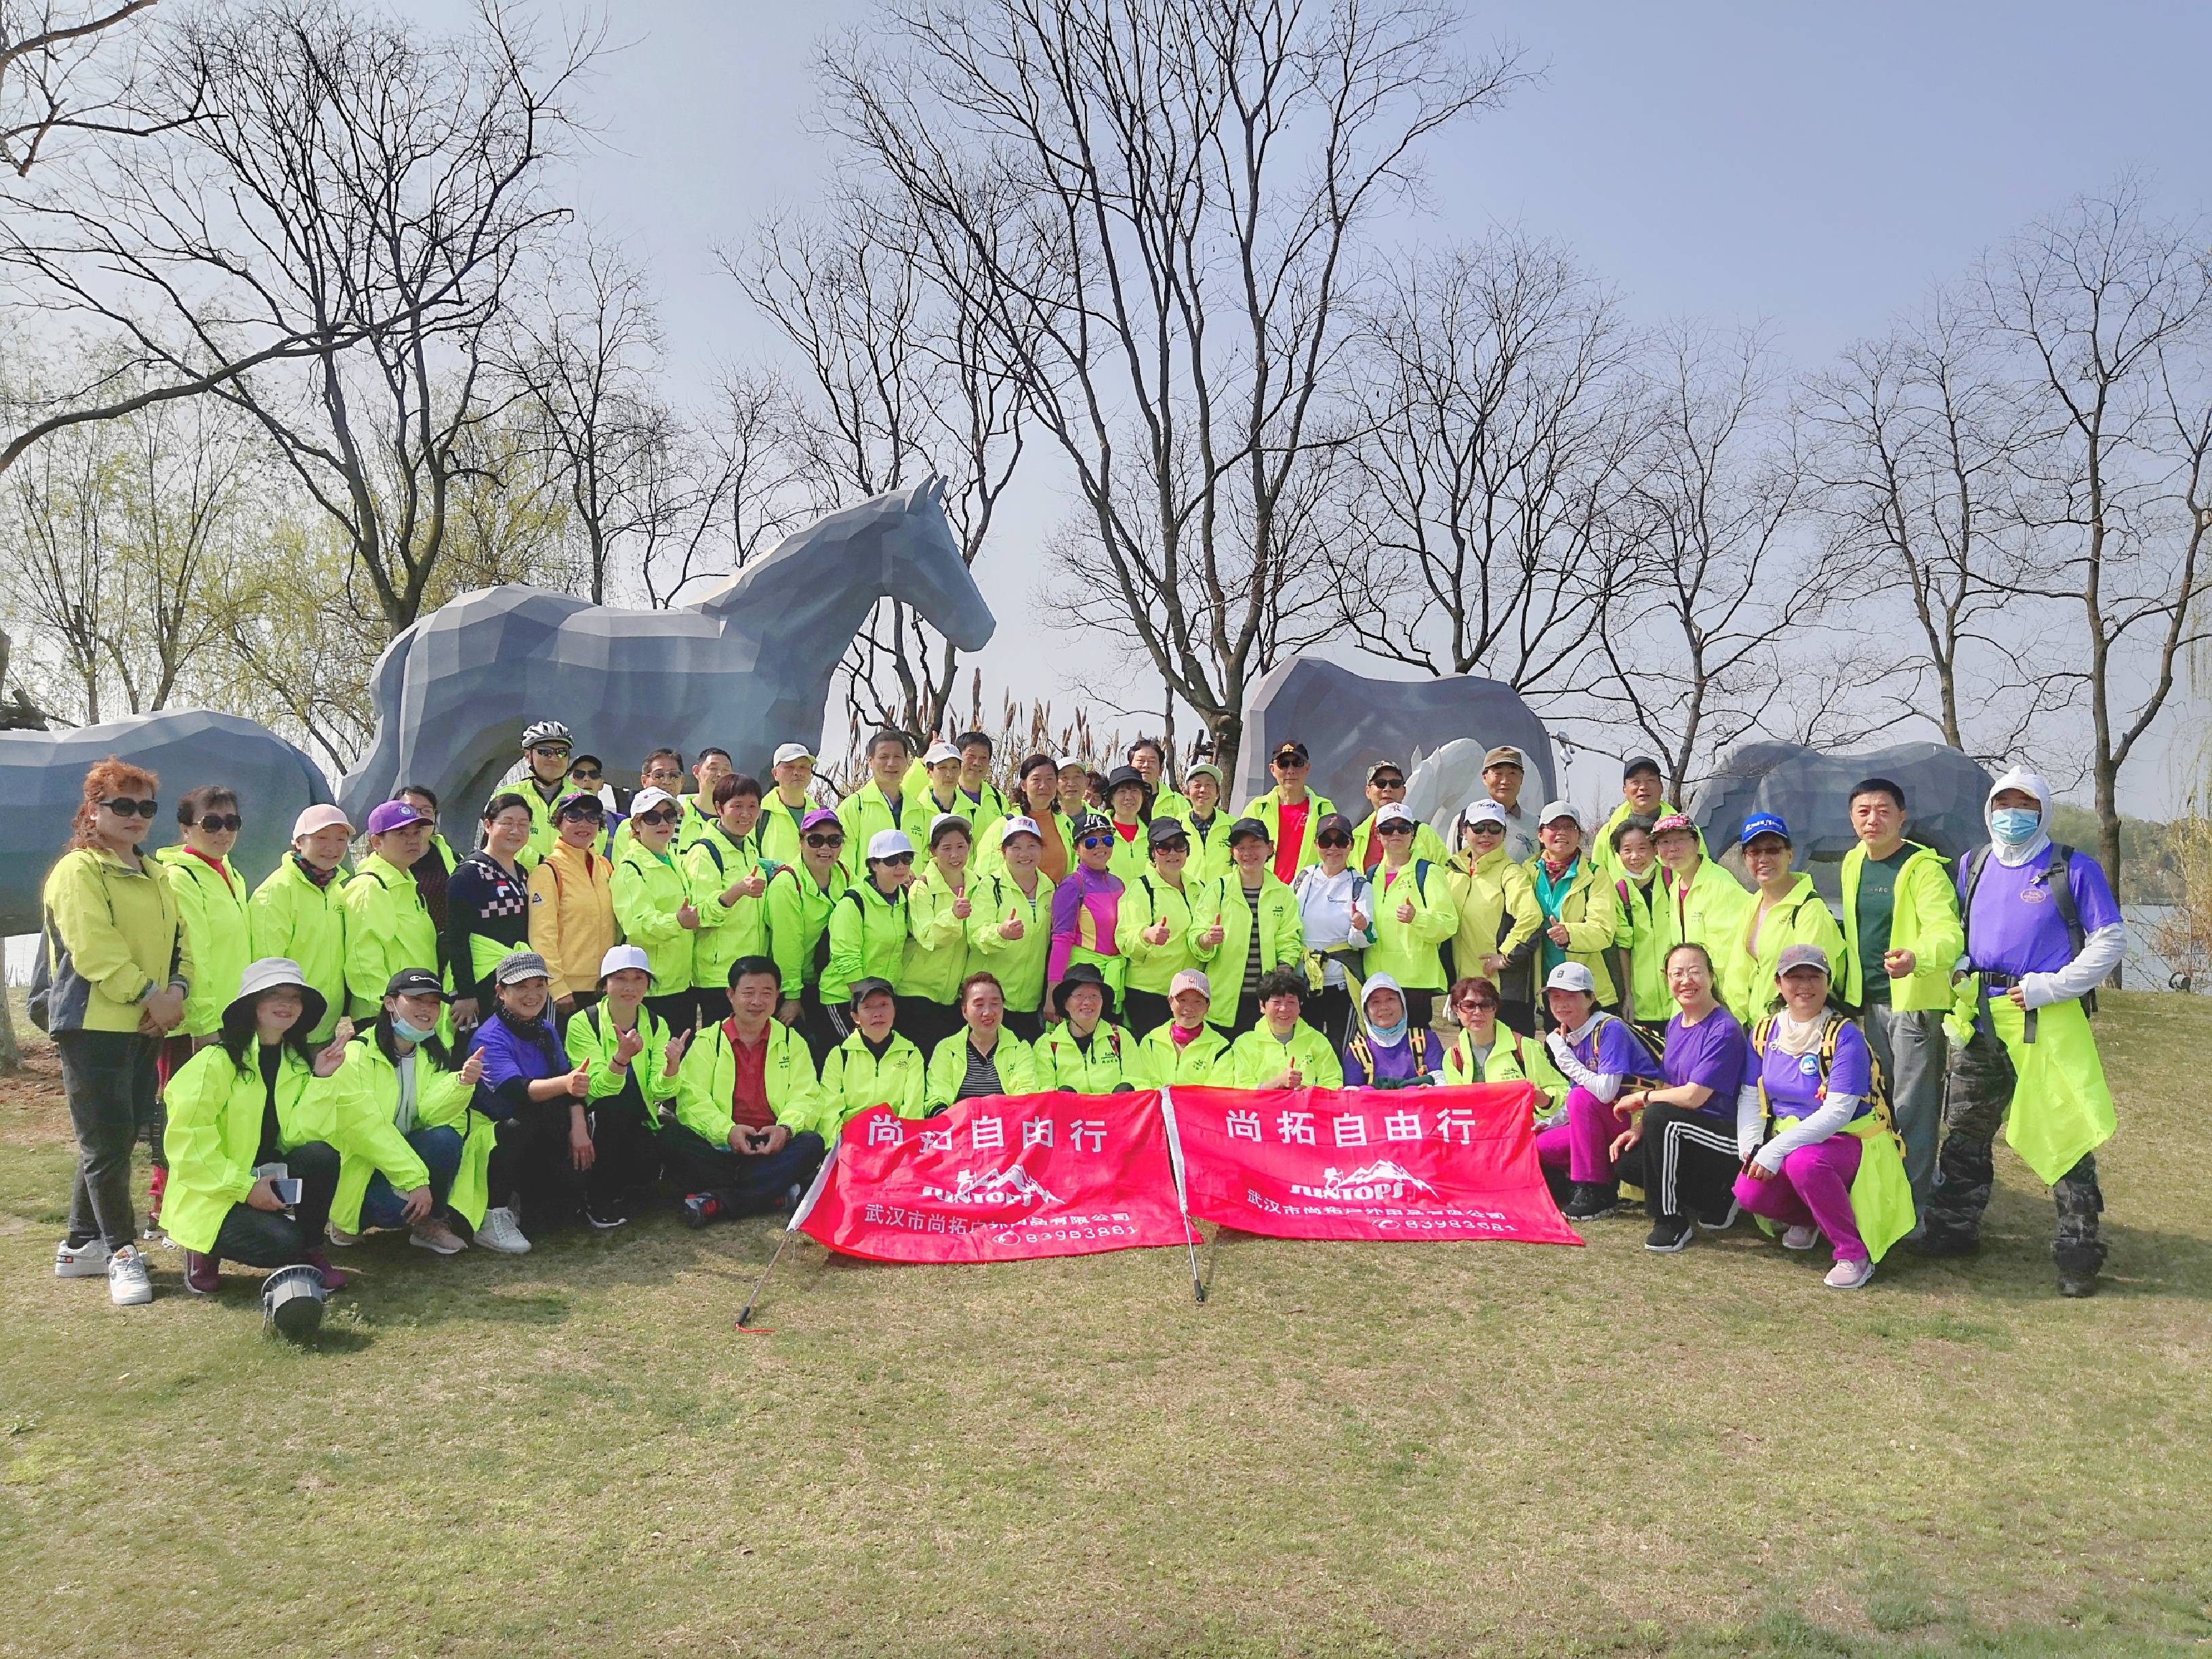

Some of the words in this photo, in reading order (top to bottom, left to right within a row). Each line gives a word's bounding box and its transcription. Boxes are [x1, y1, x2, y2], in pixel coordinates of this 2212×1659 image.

[868, 1113, 1107, 1153] 尚拓自由行
[1225, 1109, 1476, 1147] 尚拓自由行
